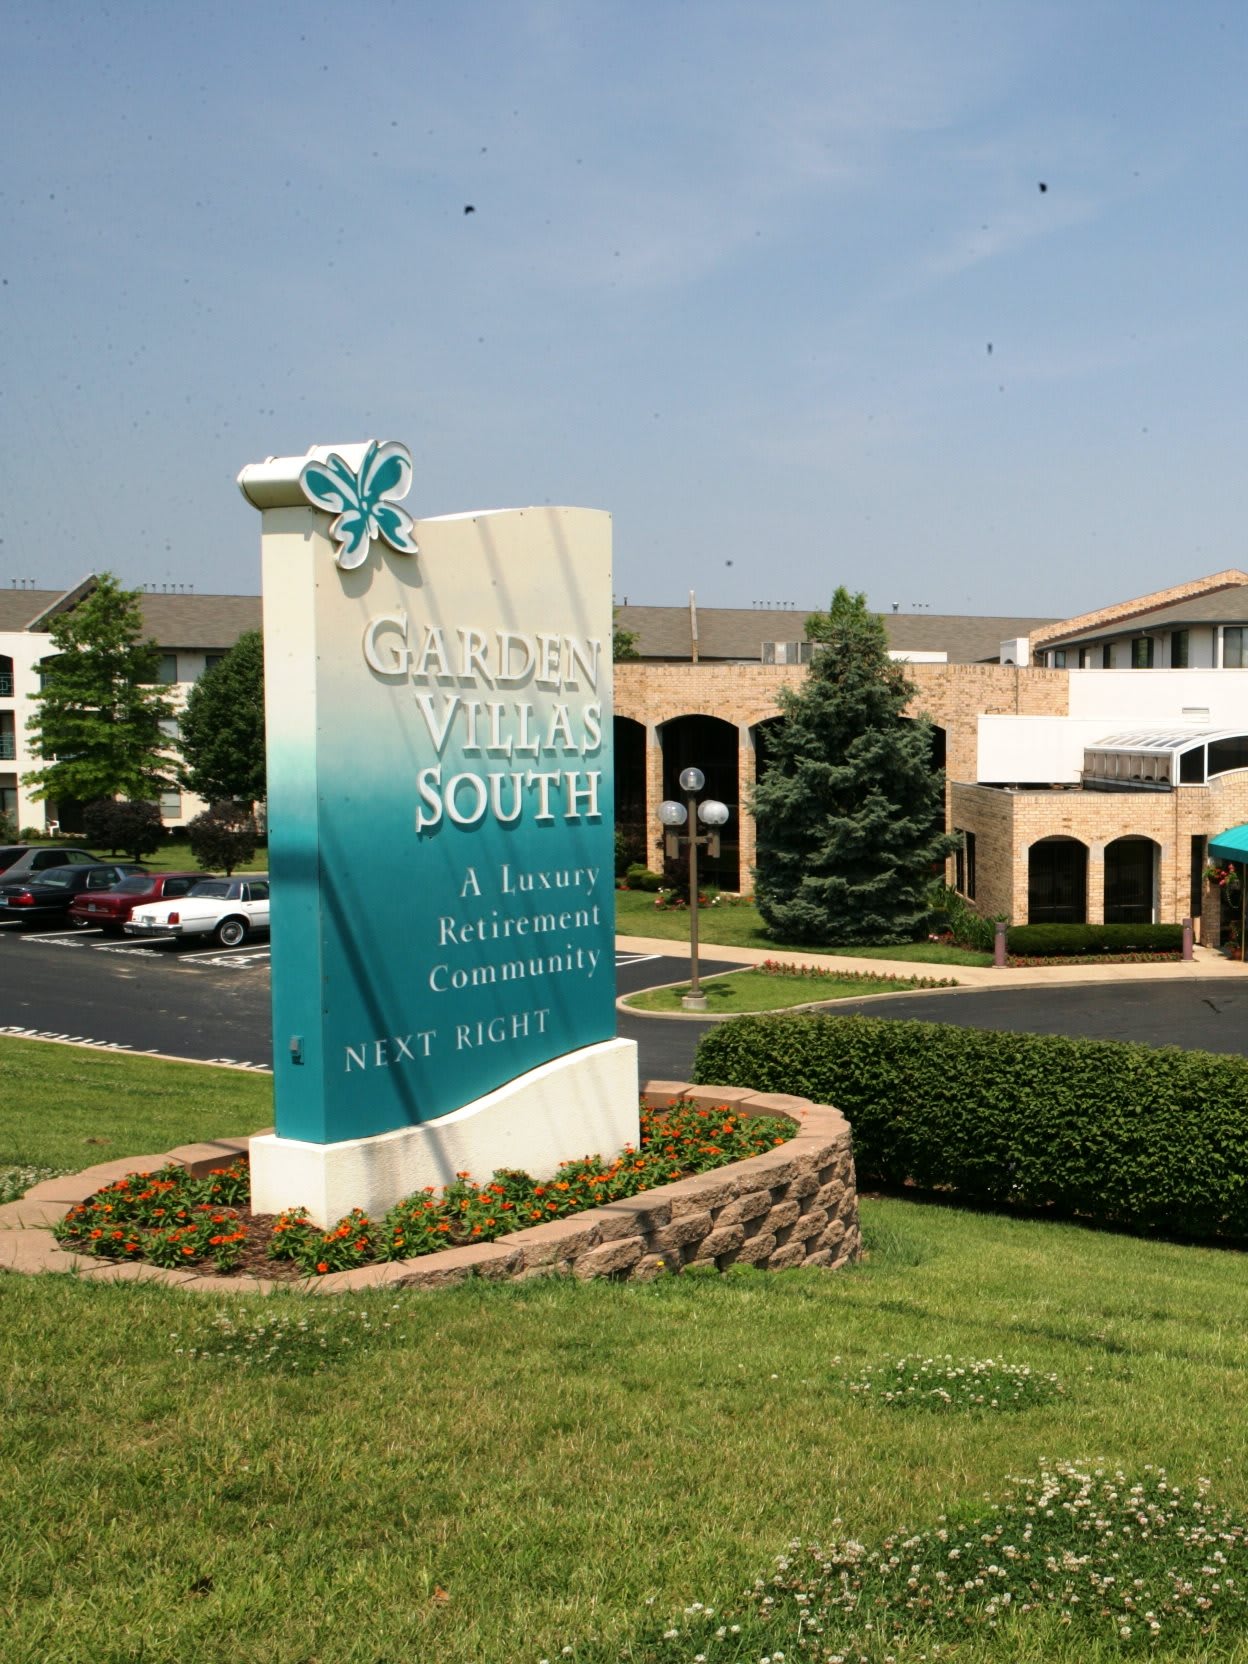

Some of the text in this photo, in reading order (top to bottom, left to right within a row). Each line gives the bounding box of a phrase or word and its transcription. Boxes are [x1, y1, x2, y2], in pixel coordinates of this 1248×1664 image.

[363, 612, 600, 690] GARDEN
[415, 692, 602, 757] VILLAS
[415, 763, 602, 832] SOUTH
[460, 864, 600, 898] A Luxury
[438, 904, 601, 946] Retirement
[429, 943, 601, 993] Community
[344, 1008, 550, 1072] NEXT RIGHT
